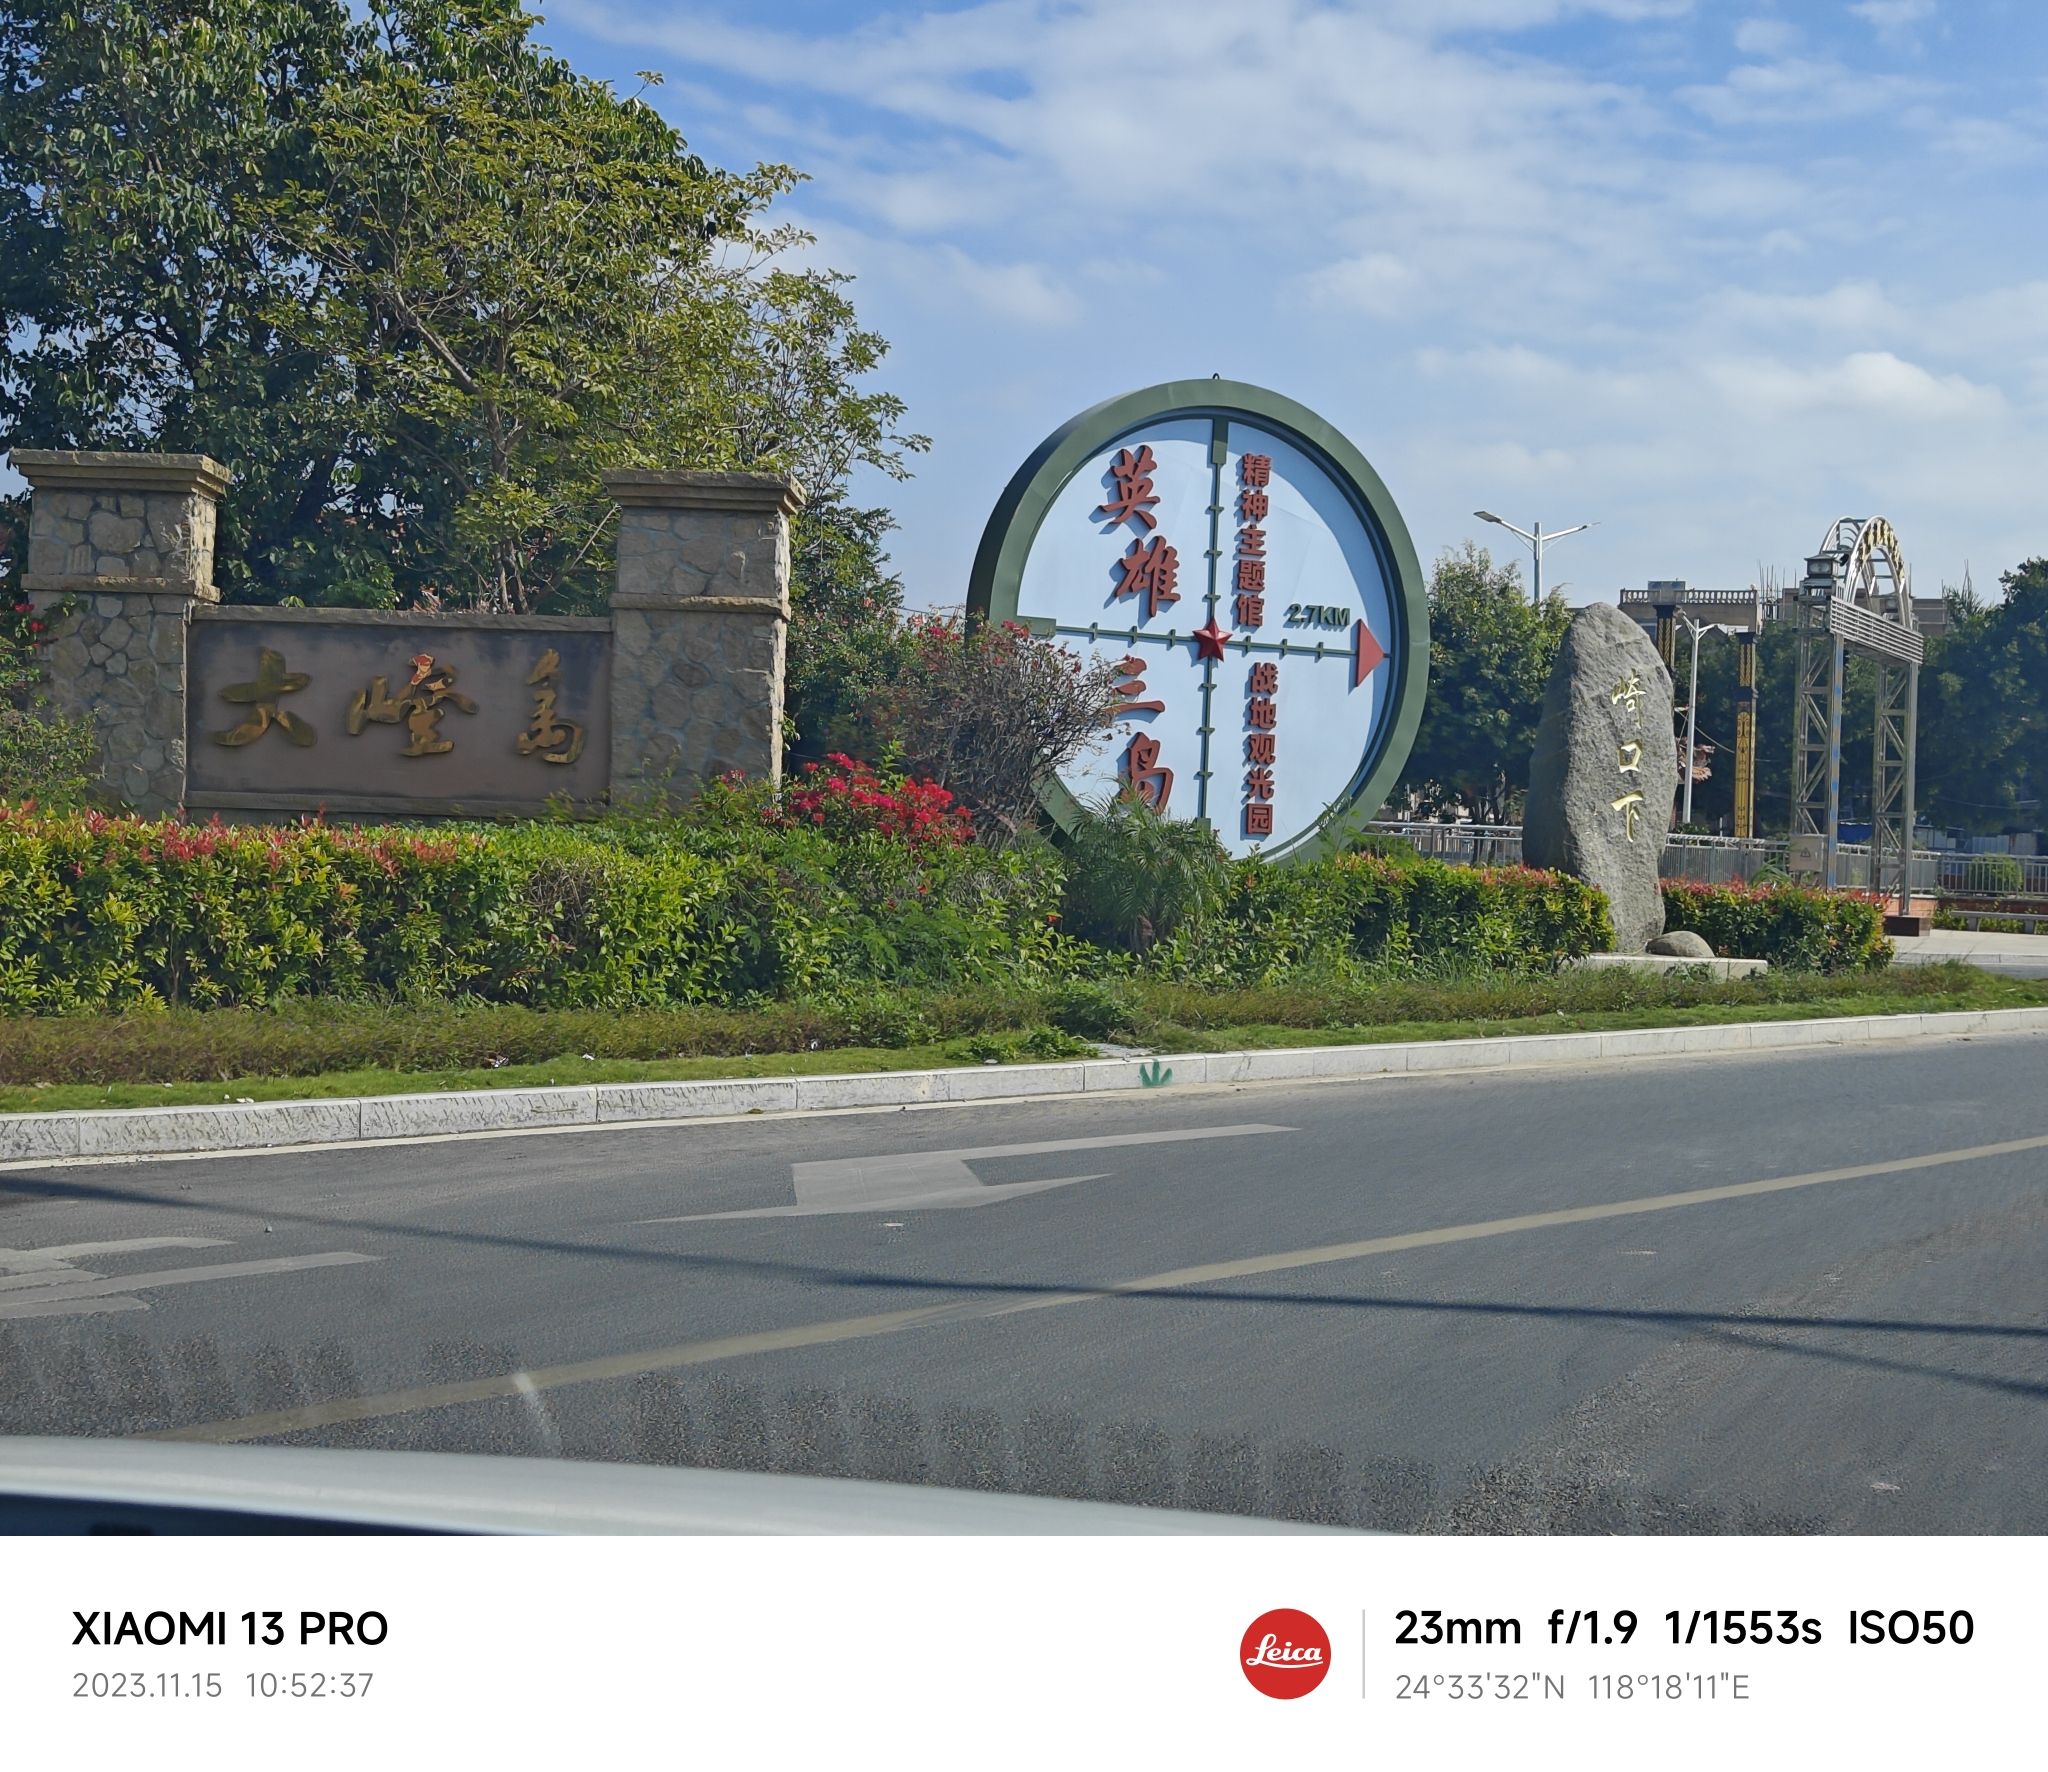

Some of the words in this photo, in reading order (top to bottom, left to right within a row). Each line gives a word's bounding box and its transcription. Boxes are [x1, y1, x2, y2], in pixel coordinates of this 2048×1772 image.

[1236, 453, 1272, 628] 精神主题馆
[1246, 662, 1278, 834] 战地观光园
